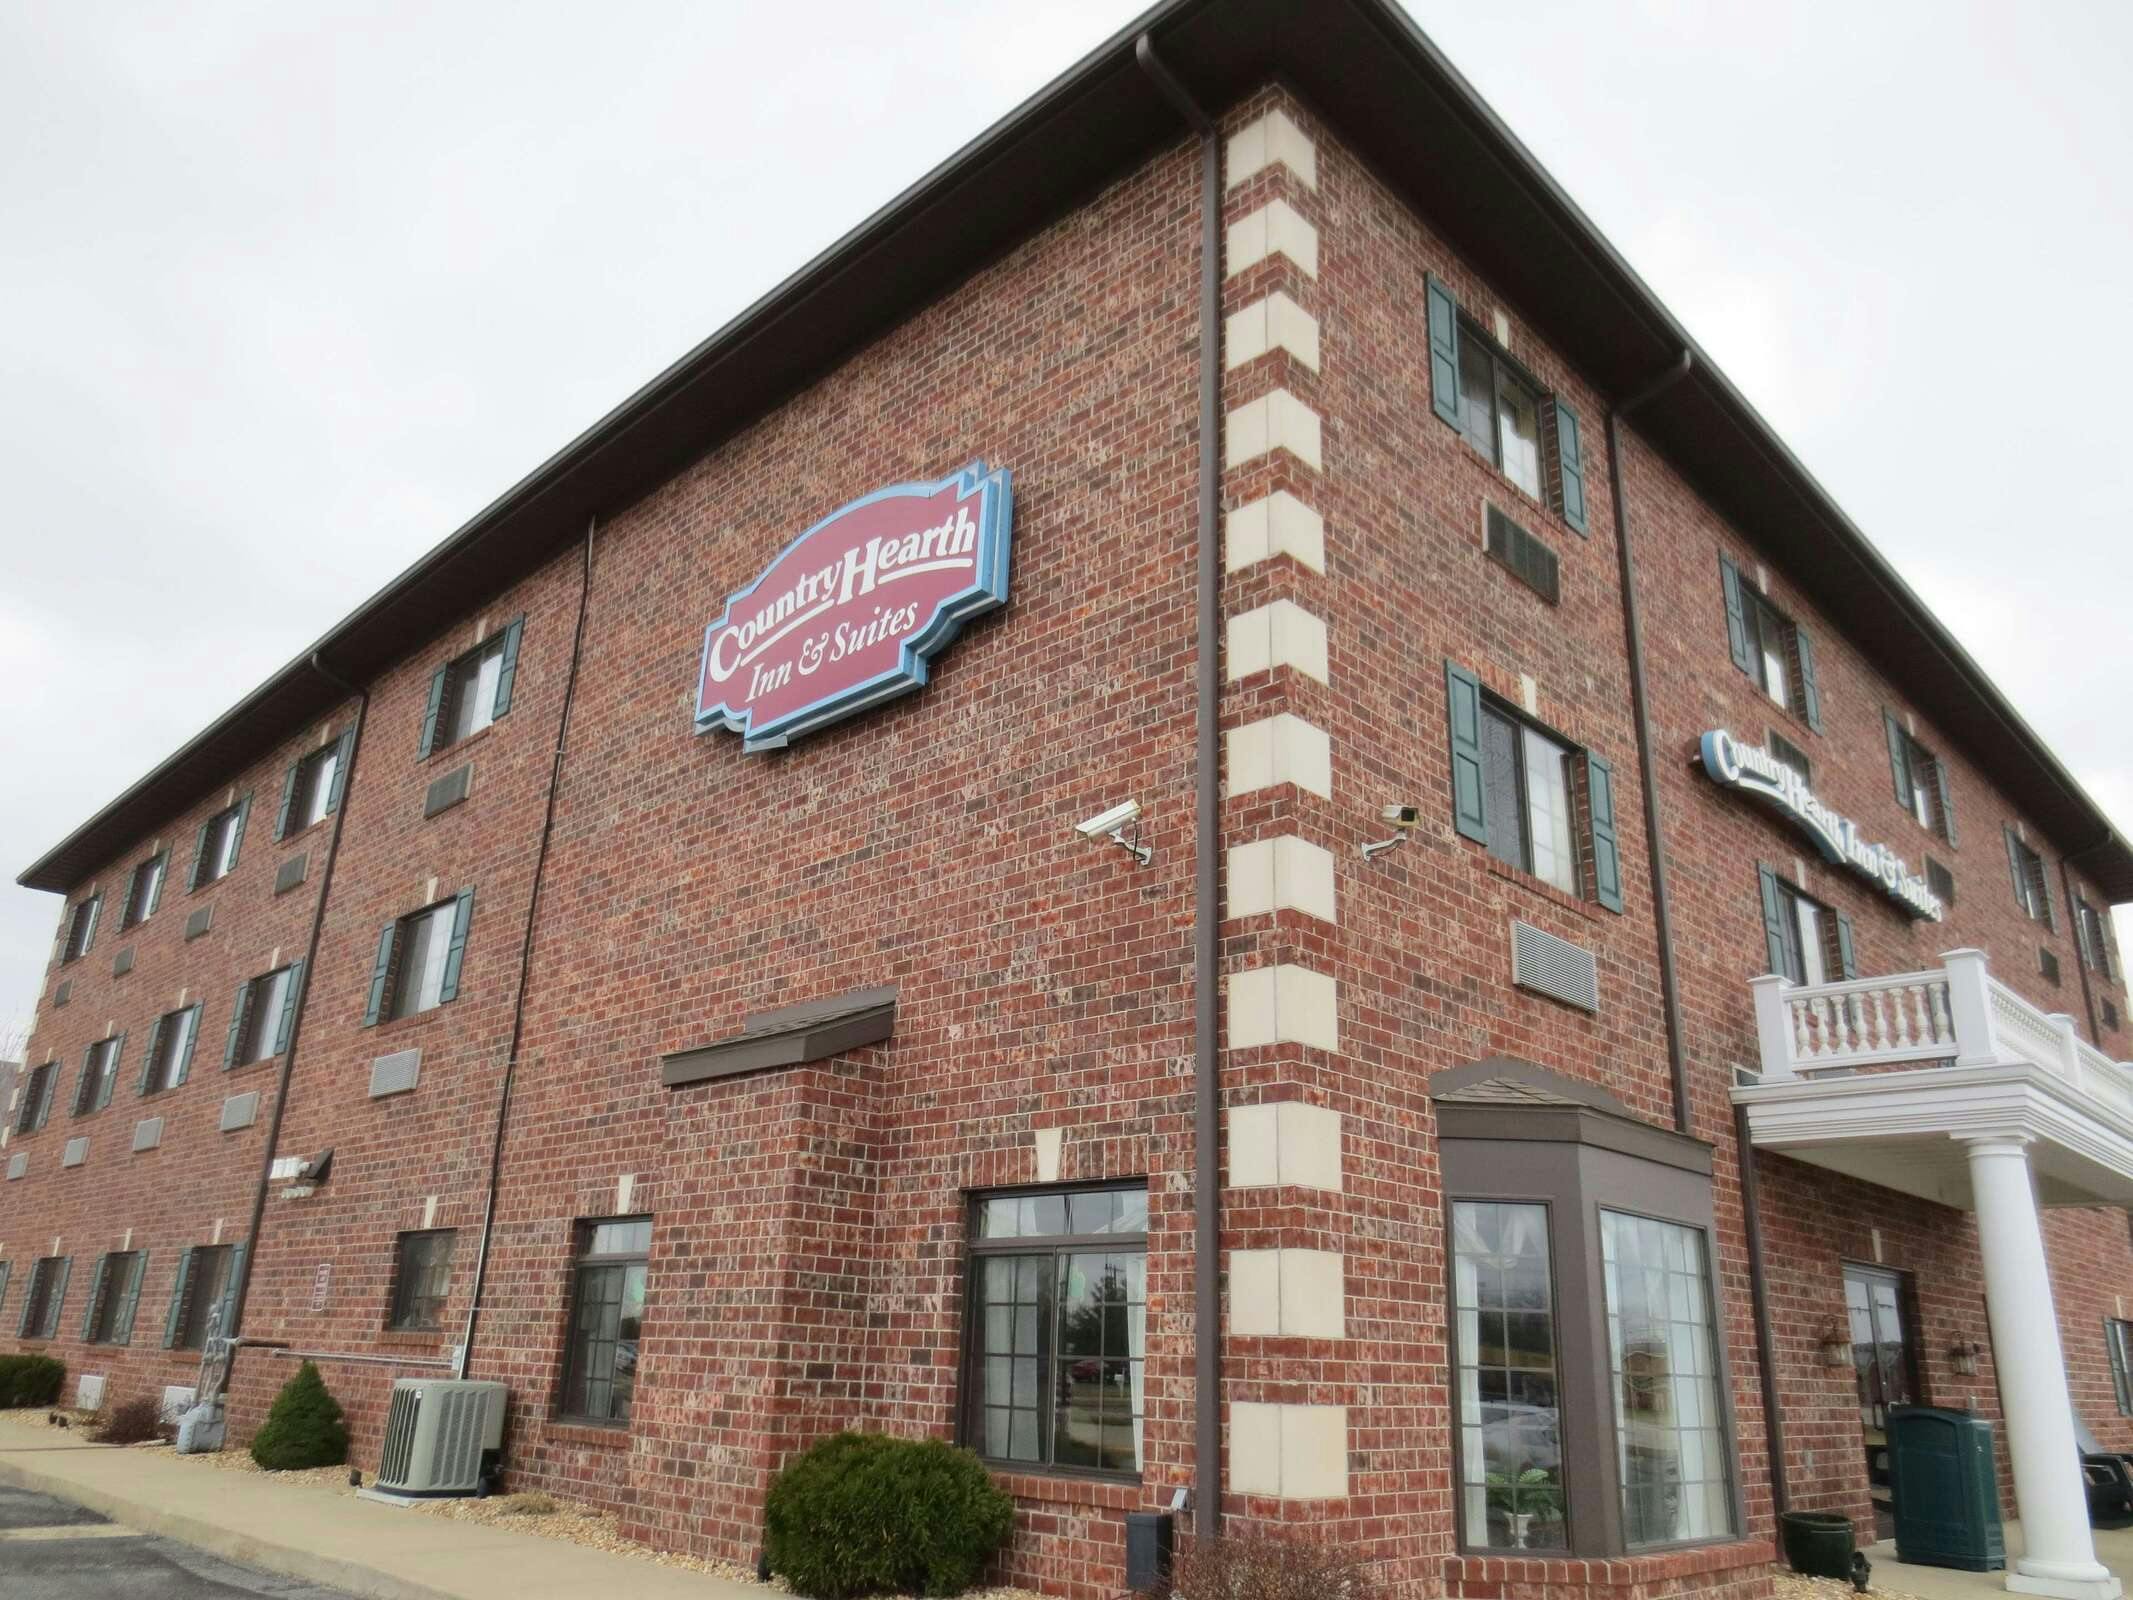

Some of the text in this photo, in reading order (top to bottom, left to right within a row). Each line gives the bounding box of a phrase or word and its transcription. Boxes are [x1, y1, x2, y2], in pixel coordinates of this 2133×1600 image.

[709, 506, 977, 683] Country Hearth
[745, 601, 919, 703] Inn & Suites
